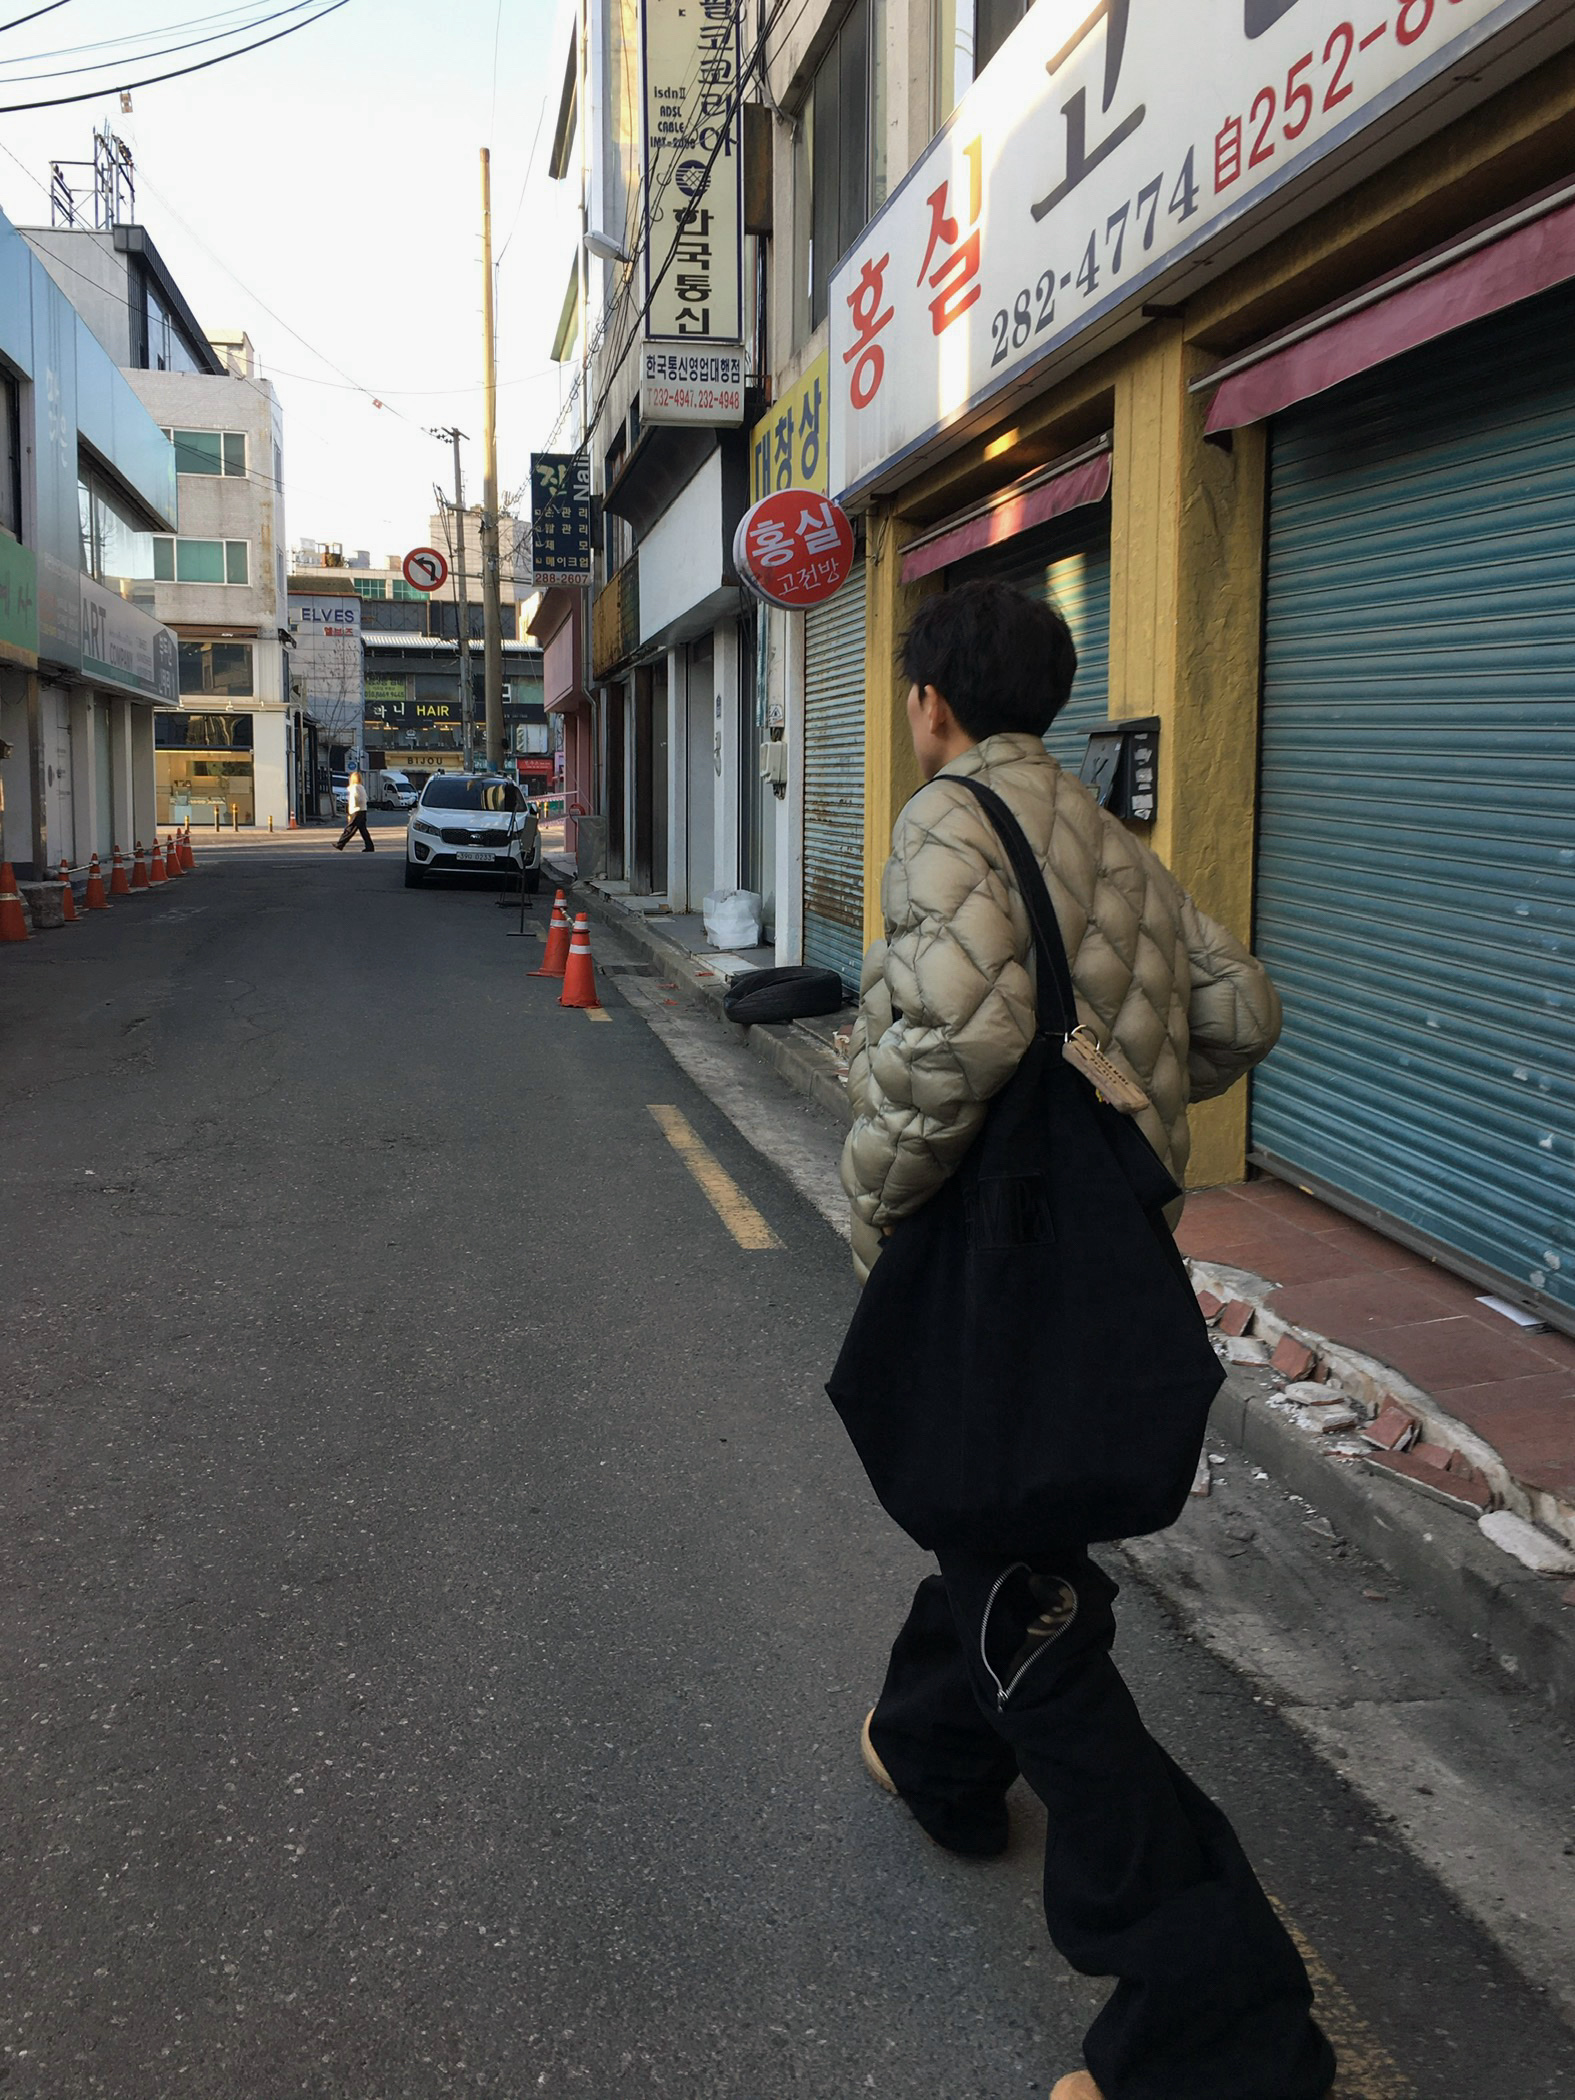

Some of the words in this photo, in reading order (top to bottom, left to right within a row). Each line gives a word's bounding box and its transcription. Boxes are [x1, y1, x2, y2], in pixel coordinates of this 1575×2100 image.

[660, 105, 682, 118] ADSL
[657, 121, 685, 134] CABLE
[990, 143, 1200, 370] 282-4774
[672, 207, 714, 335] 한국통신
[646, 354, 740, 384] 한국통신영업대행점
[749, 502, 842, 568] 홍실
[535, 572, 589, 584] 288-2607
[301, 607, 355, 623] ELVES
[81, 597, 107, 661] ART
[416, 705, 450, 717] HAIR
[407, 756, 443, 765] BIJOU
